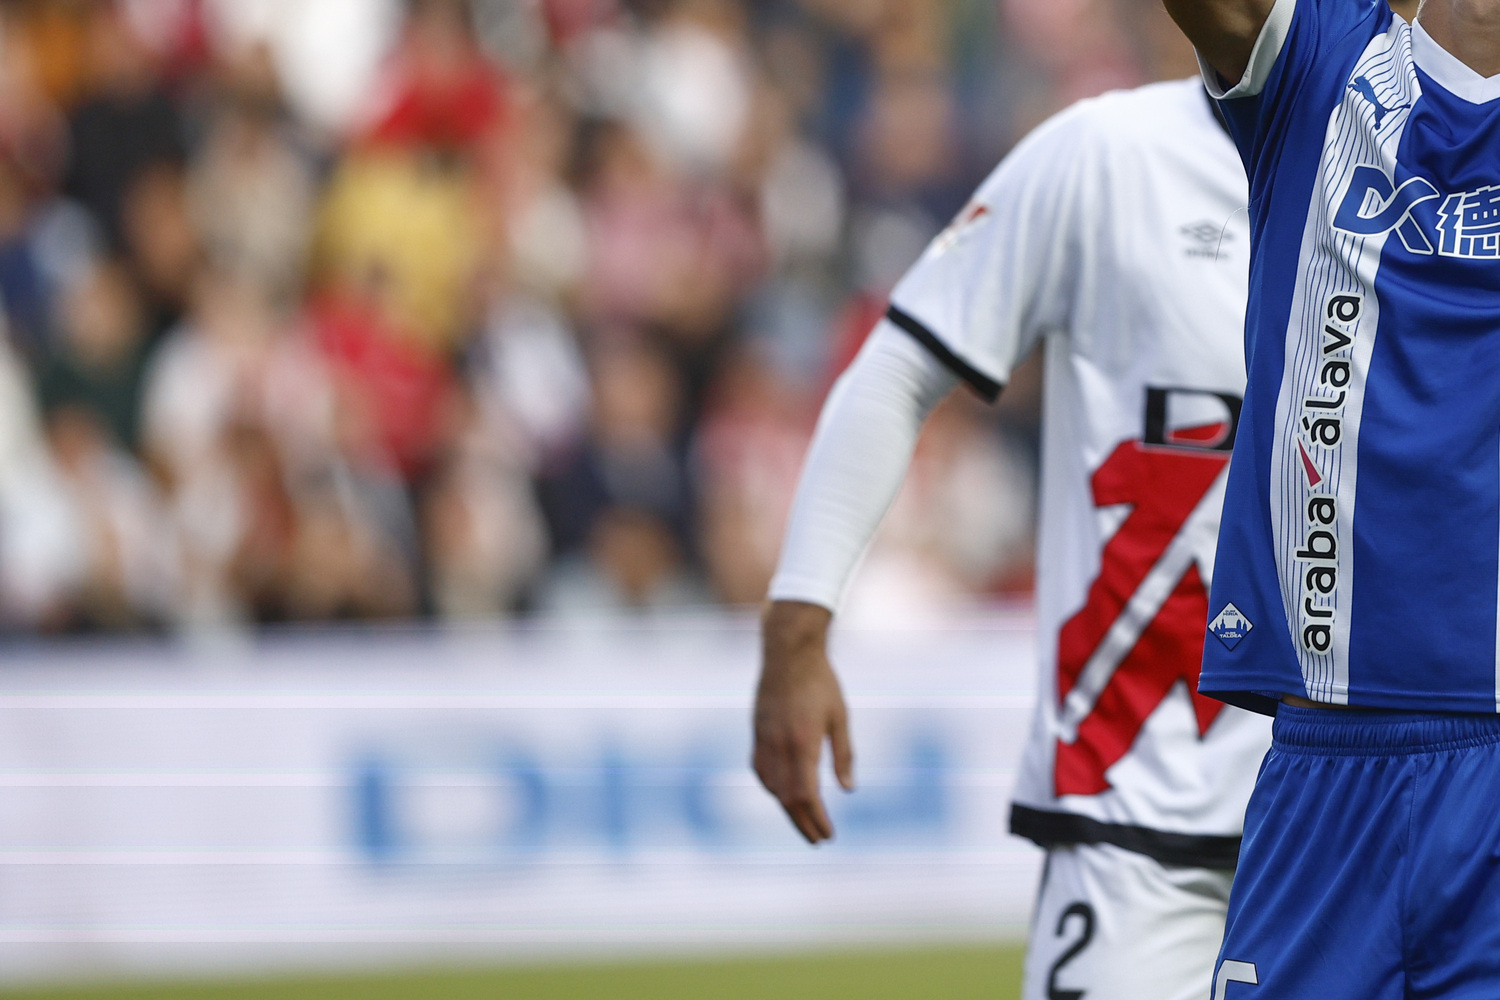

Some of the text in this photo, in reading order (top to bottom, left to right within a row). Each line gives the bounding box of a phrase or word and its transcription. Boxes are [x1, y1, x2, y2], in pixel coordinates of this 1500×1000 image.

[1296, 294, 1361, 652] araba álava
[1046, 901, 1095, 1000] 2
